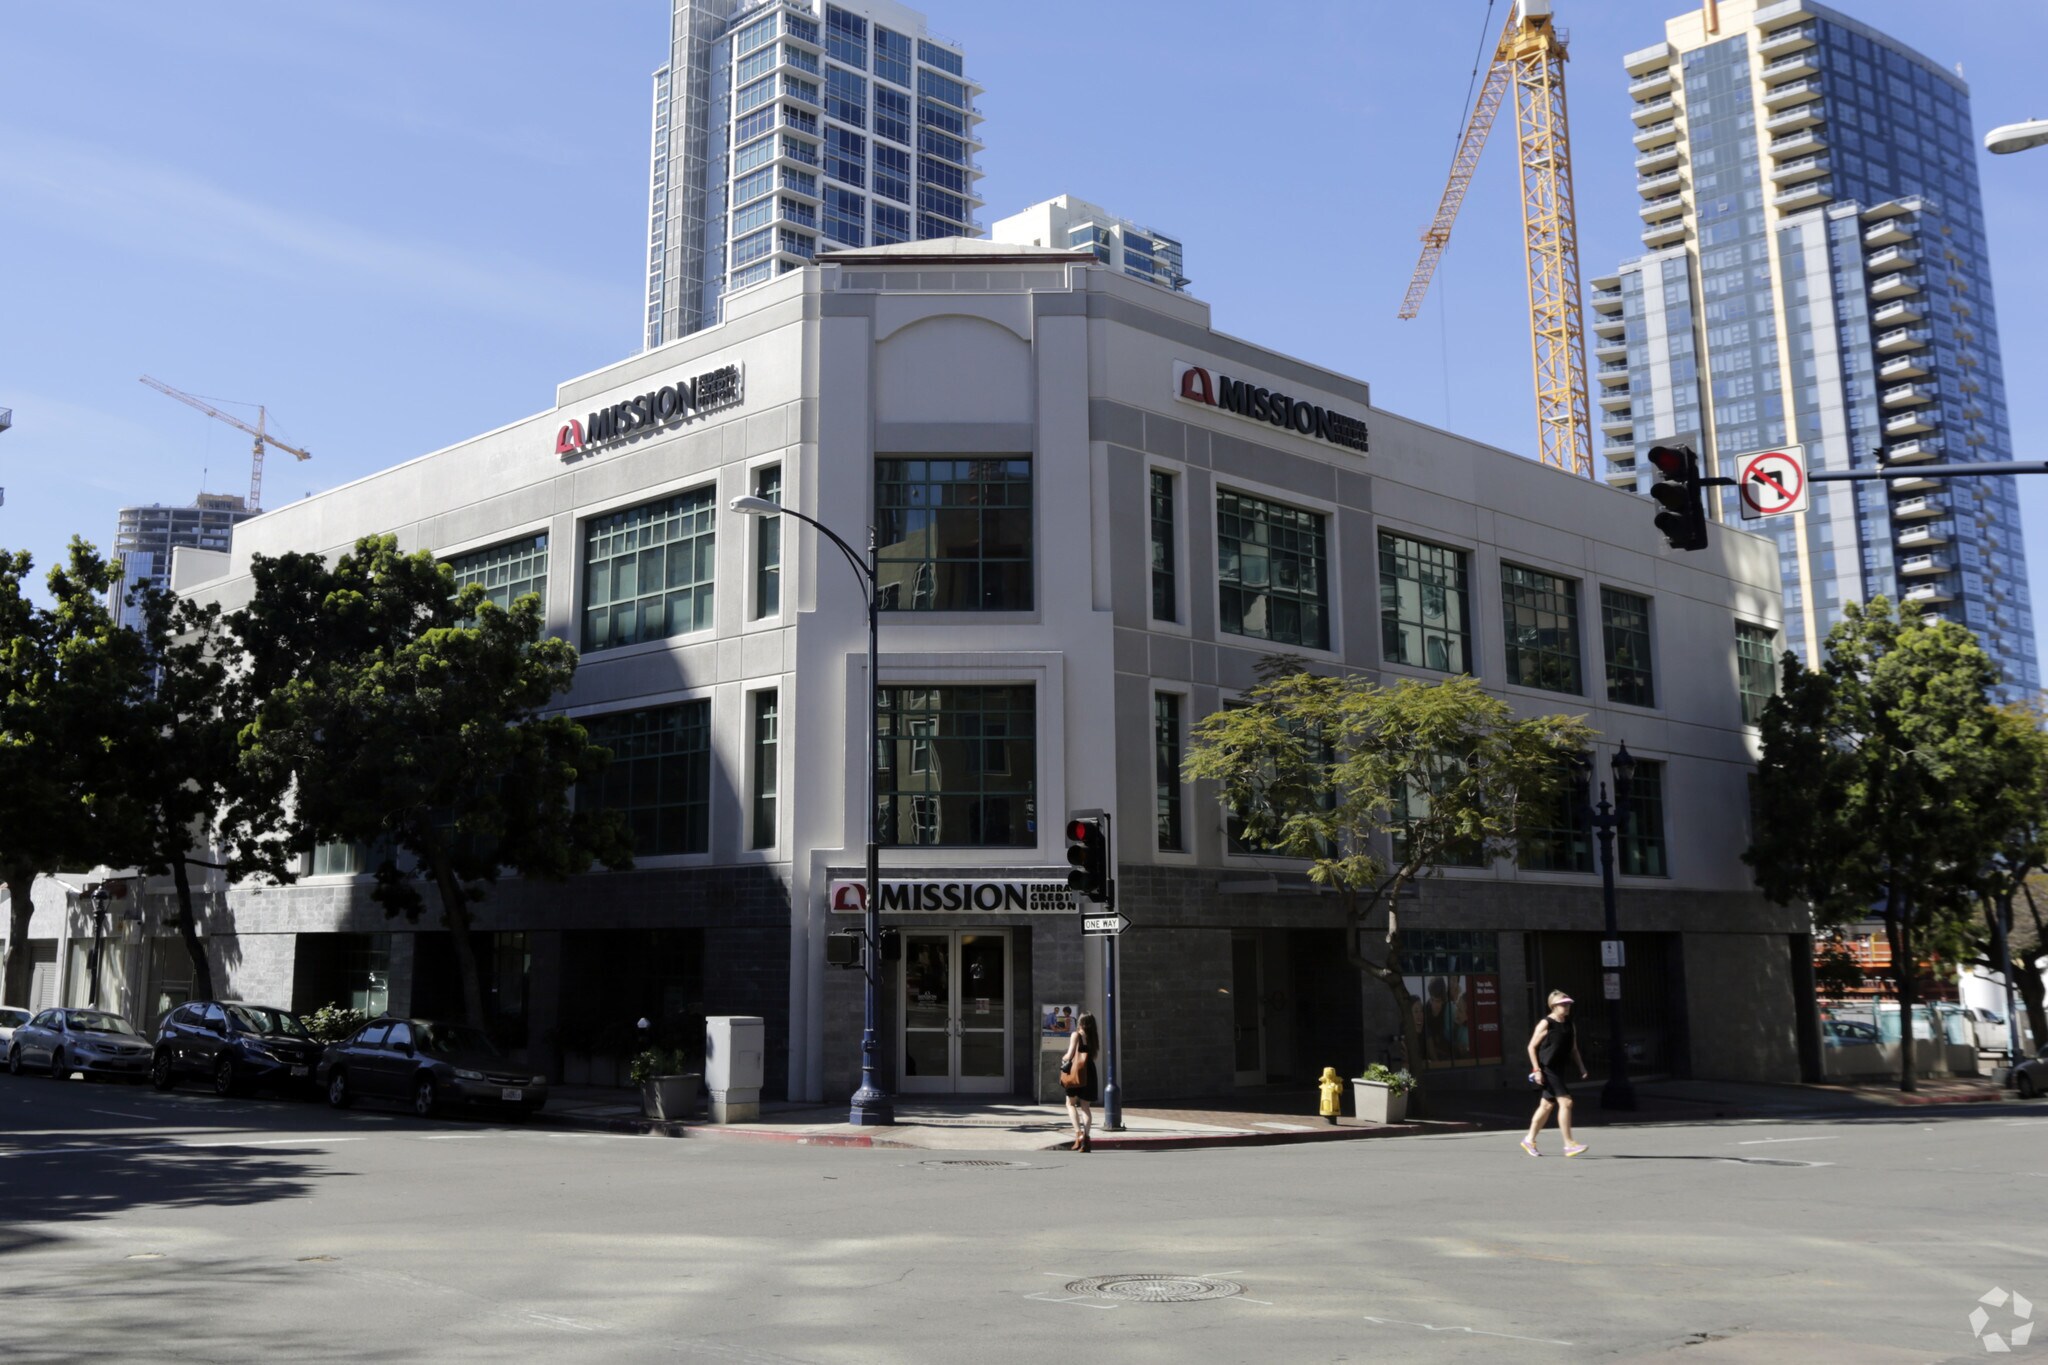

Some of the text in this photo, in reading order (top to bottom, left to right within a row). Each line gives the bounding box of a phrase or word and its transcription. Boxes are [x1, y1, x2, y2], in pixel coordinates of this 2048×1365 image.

[587, 376, 697, 444] MISSION
[1219, 375, 1335, 443] MISSION
[879, 883, 1027, 911] MISSION
[1030, 883, 1072, 892] FEDERA
[1030, 902, 1076, 911] UNION
[1085, 919, 1117, 929] ONE WAY
